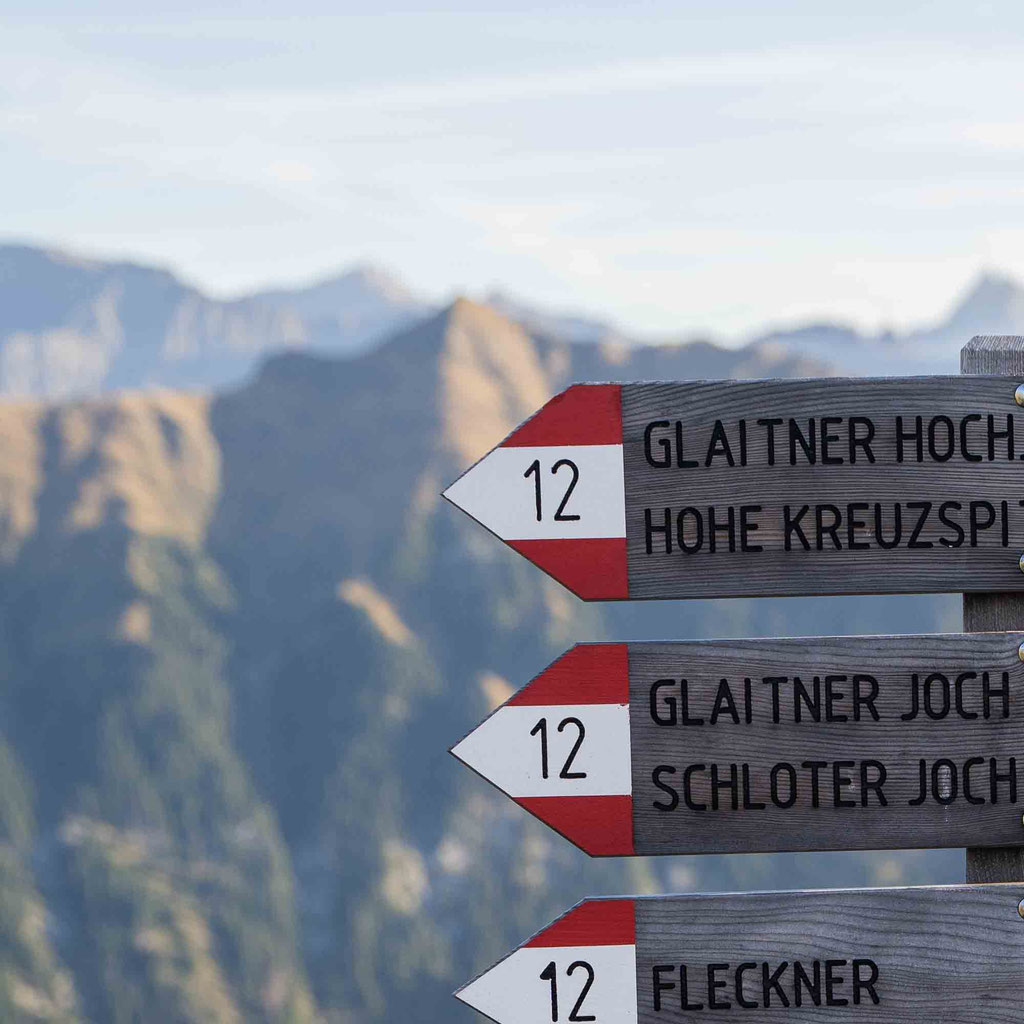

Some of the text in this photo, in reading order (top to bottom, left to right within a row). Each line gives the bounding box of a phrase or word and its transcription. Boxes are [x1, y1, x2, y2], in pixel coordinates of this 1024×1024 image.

[644, 416, 875, 469] GLAITNER
[524, 459, 580, 522] 12
[645, 505, 763, 554] HOHE
[649, 673, 880, 726] GLAITNER
[901, 670, 1010, 721] JOCH
[530, 716, 587, 780] 12
[652, 758, 887, 811] SCHLOTER
[908, 756, 1017, 807] JOCH
[540, 960, 596, 1023] 12
[653, 958, 880, 1012] FLECKNER
